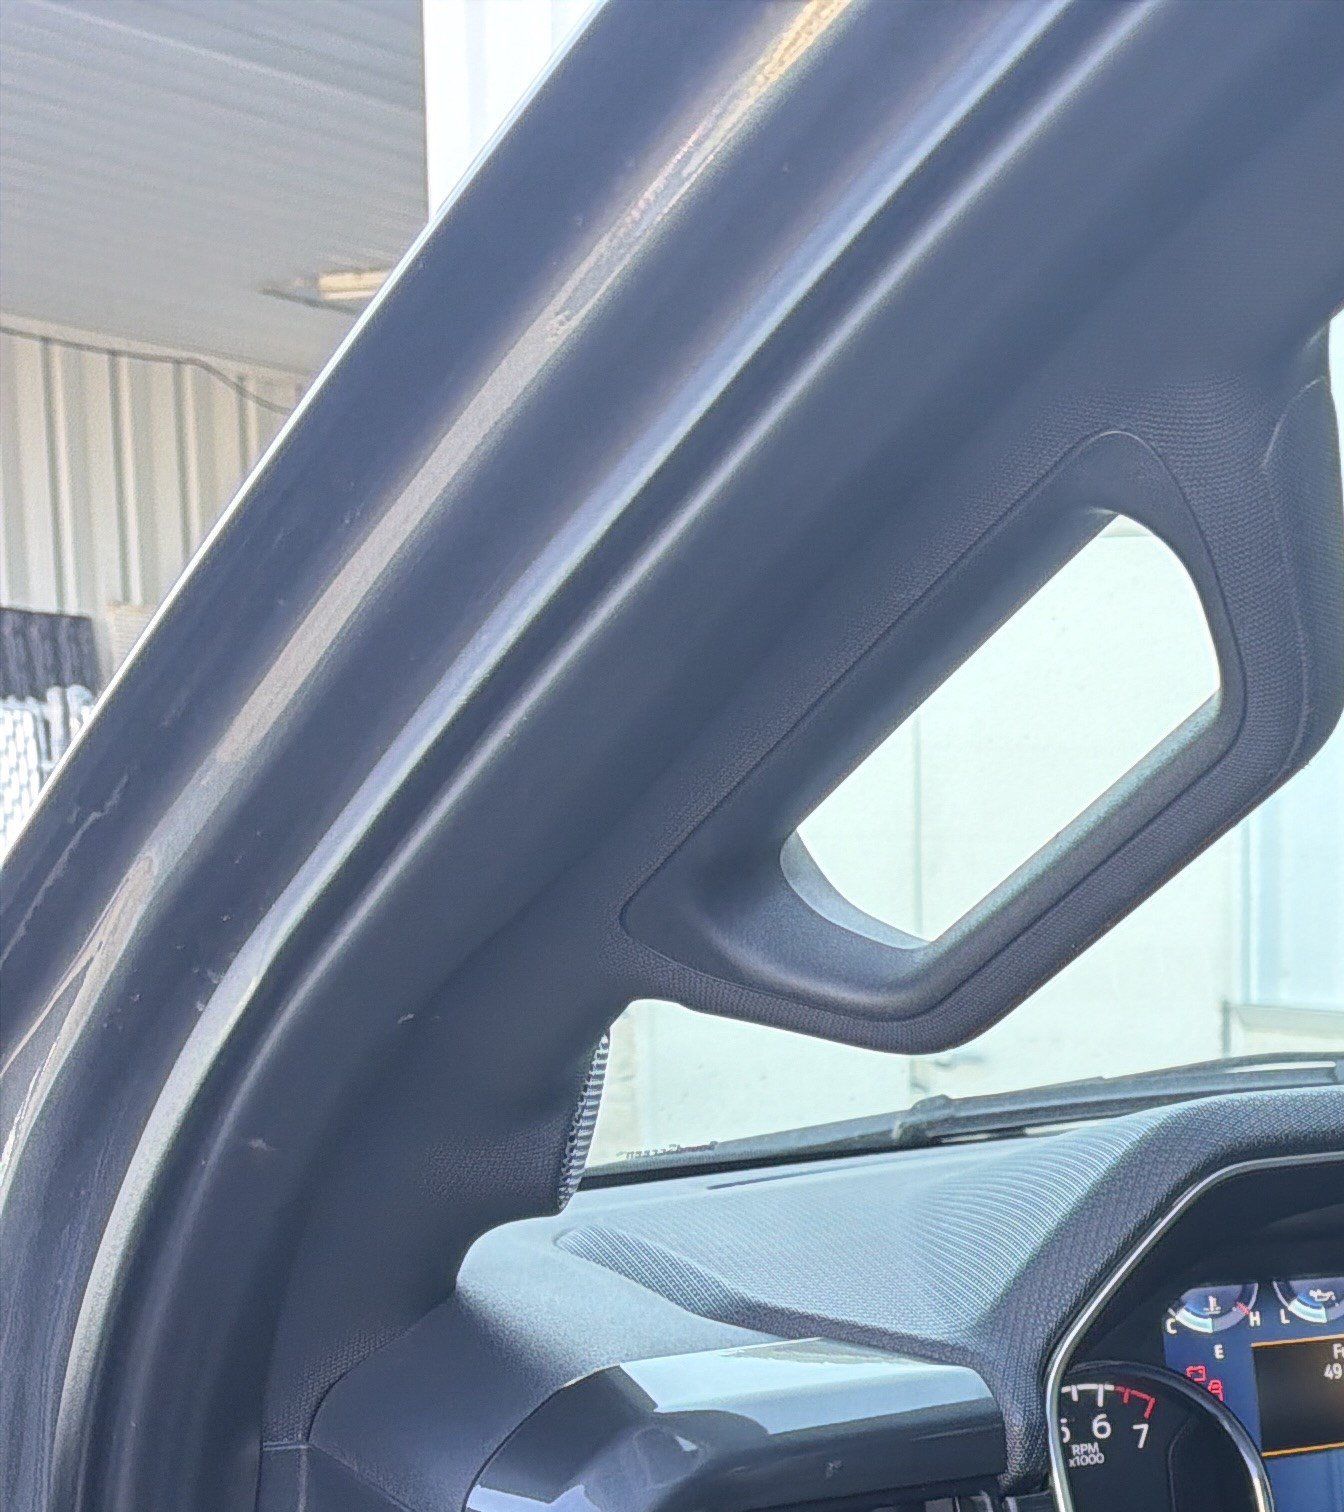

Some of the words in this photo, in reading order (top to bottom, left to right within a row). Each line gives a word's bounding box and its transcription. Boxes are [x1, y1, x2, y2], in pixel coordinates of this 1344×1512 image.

[1249, 1311, 1260, 1327] H
[1280, 1309, 1290, 1324] L
[1166, 1318, 1178, 1334] C
[1213, 1344, 1225, 1360] E
[1323, 1363, 1343, 1380] 49
[1092, 1413, 1112, 1439] 6
[1132, 1423, 1149, 1449] 7
[1071, 1442, 1100, 1456] RPM
[1068, 1452, 1105, 1468] x1000
